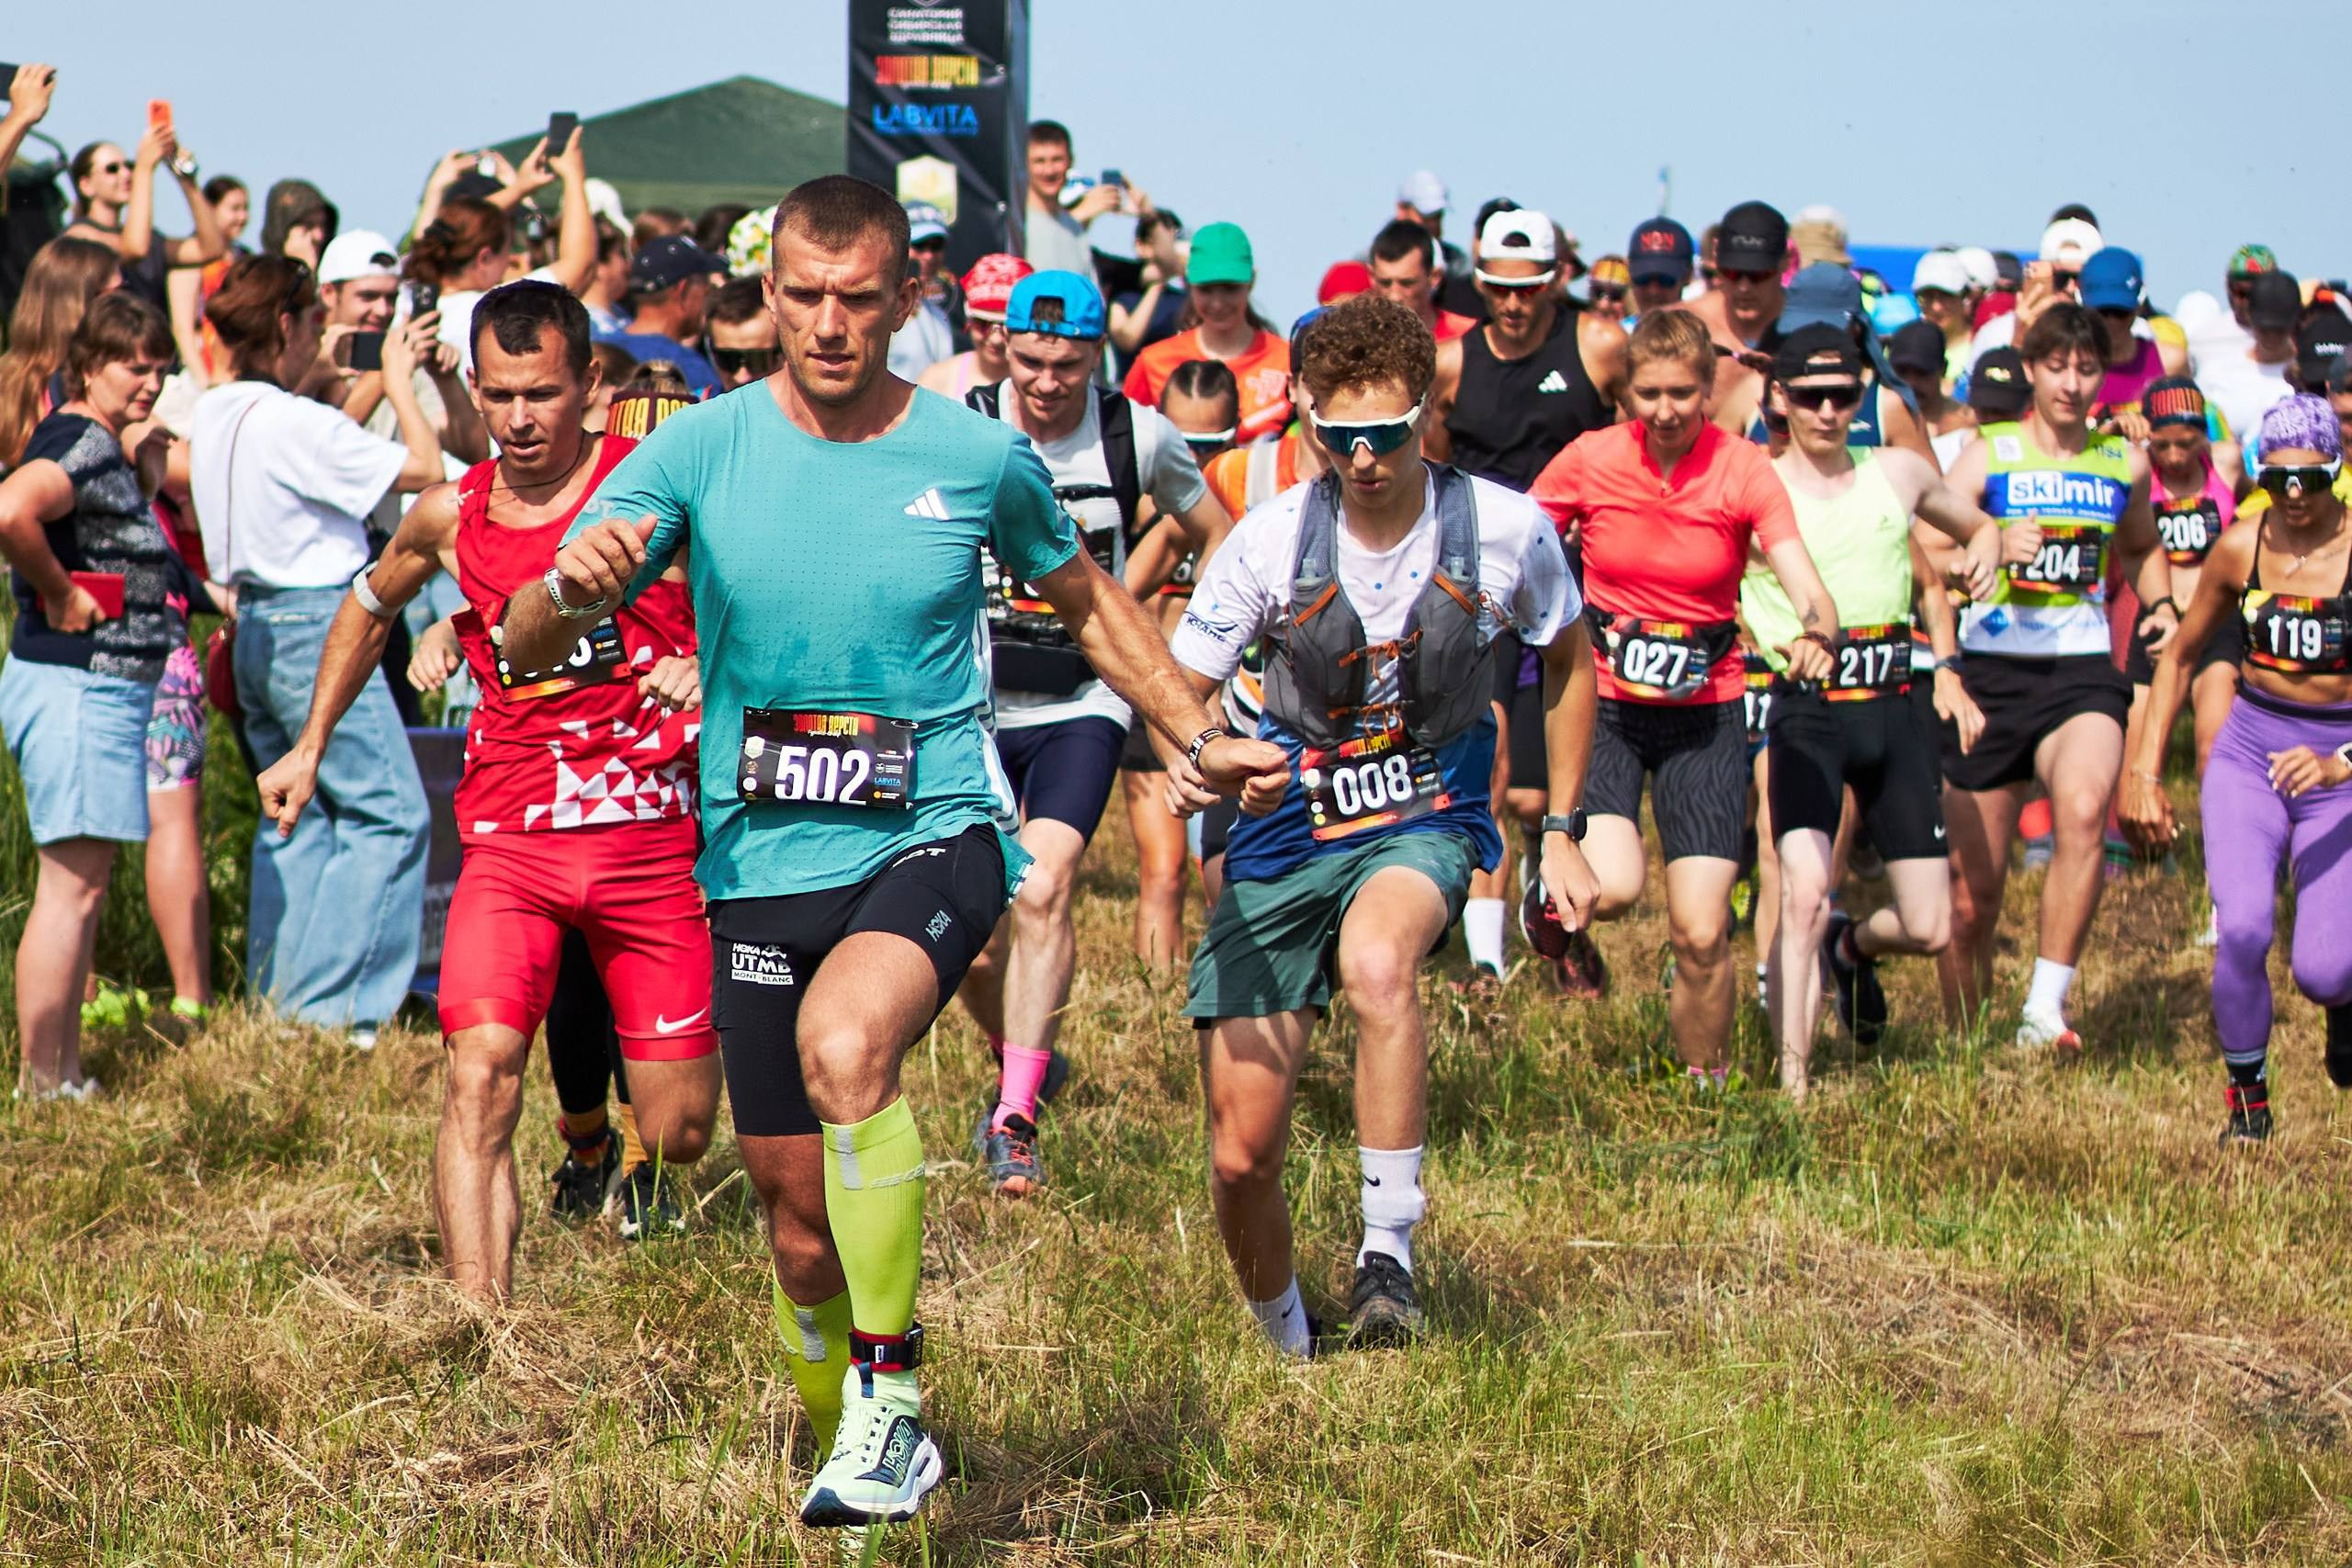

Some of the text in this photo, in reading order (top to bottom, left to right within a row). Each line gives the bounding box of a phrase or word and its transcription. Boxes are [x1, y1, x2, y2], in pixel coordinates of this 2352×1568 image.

[873, 103, 979, 128] LABVITA
[2012, 473, 2115, 508] skimir
[2158, 513, 2207, 550] 206
[2026, 544, 2080, 582] 204
[2267, 614, 2322, 660] 119
[1623, 638, 1689, 686] 027
[1839, 644, 1894, 686] 217
[775, 745, 870, 806] 502
[1332, 754, 1413, 816] 008
[924, 909, 952, 942] HOKA
[731, 953, 791, 974] UTMB
[732, 942, 761, 956] HOKA
